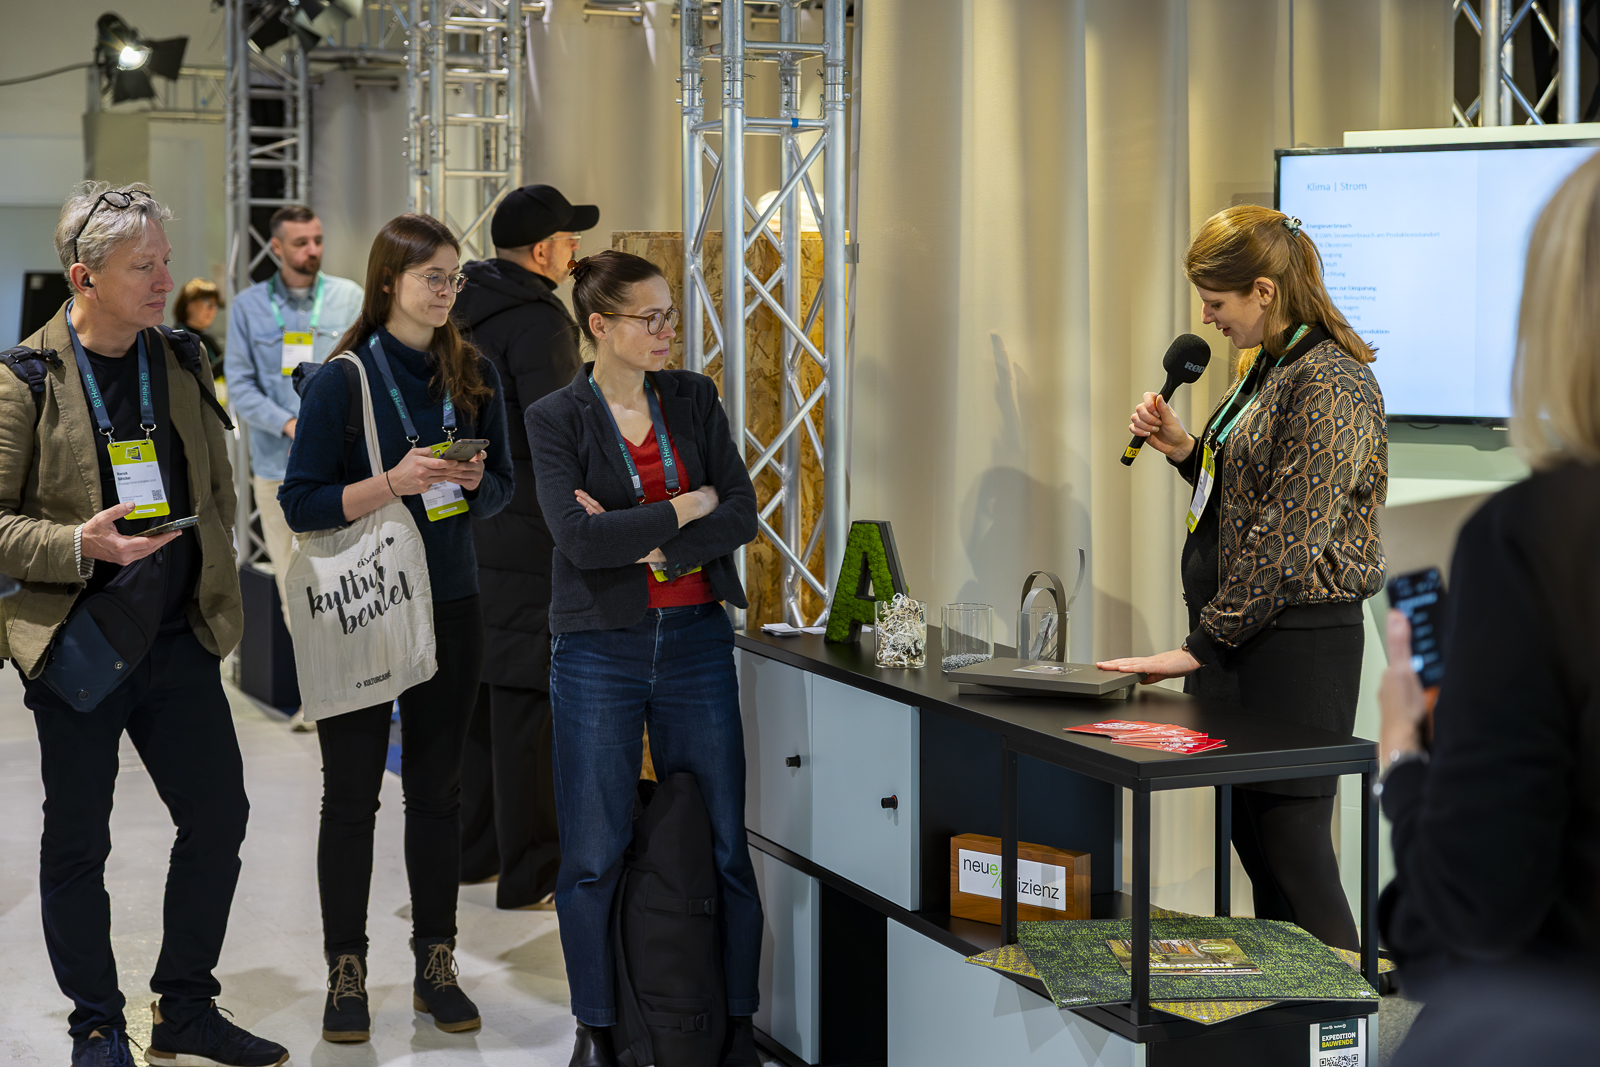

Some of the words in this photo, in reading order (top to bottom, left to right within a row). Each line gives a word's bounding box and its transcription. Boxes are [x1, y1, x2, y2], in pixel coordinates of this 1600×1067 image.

[1306, 182, 1331, 191] Klima
[1340, 182, 1367, 191] Strom
[1184, 361, 1206, 374] RØD
[86, 373, 99, 400] Heinze
[141, 381, 149, 406] Heinze
[393, 396, 407, 419] Heinze
[660, 434, 671, 458] Heinze
[306, 560, 386, 619] kultur
[825, 520, 908, 644] A
[337, 571, 414, 635] beutel
[963, 858, 998, 876] neue
[1321, 1031, 1356, 1042] EXPEDITION
[1321, 1038, 1354, 1048] BAUWENDE
